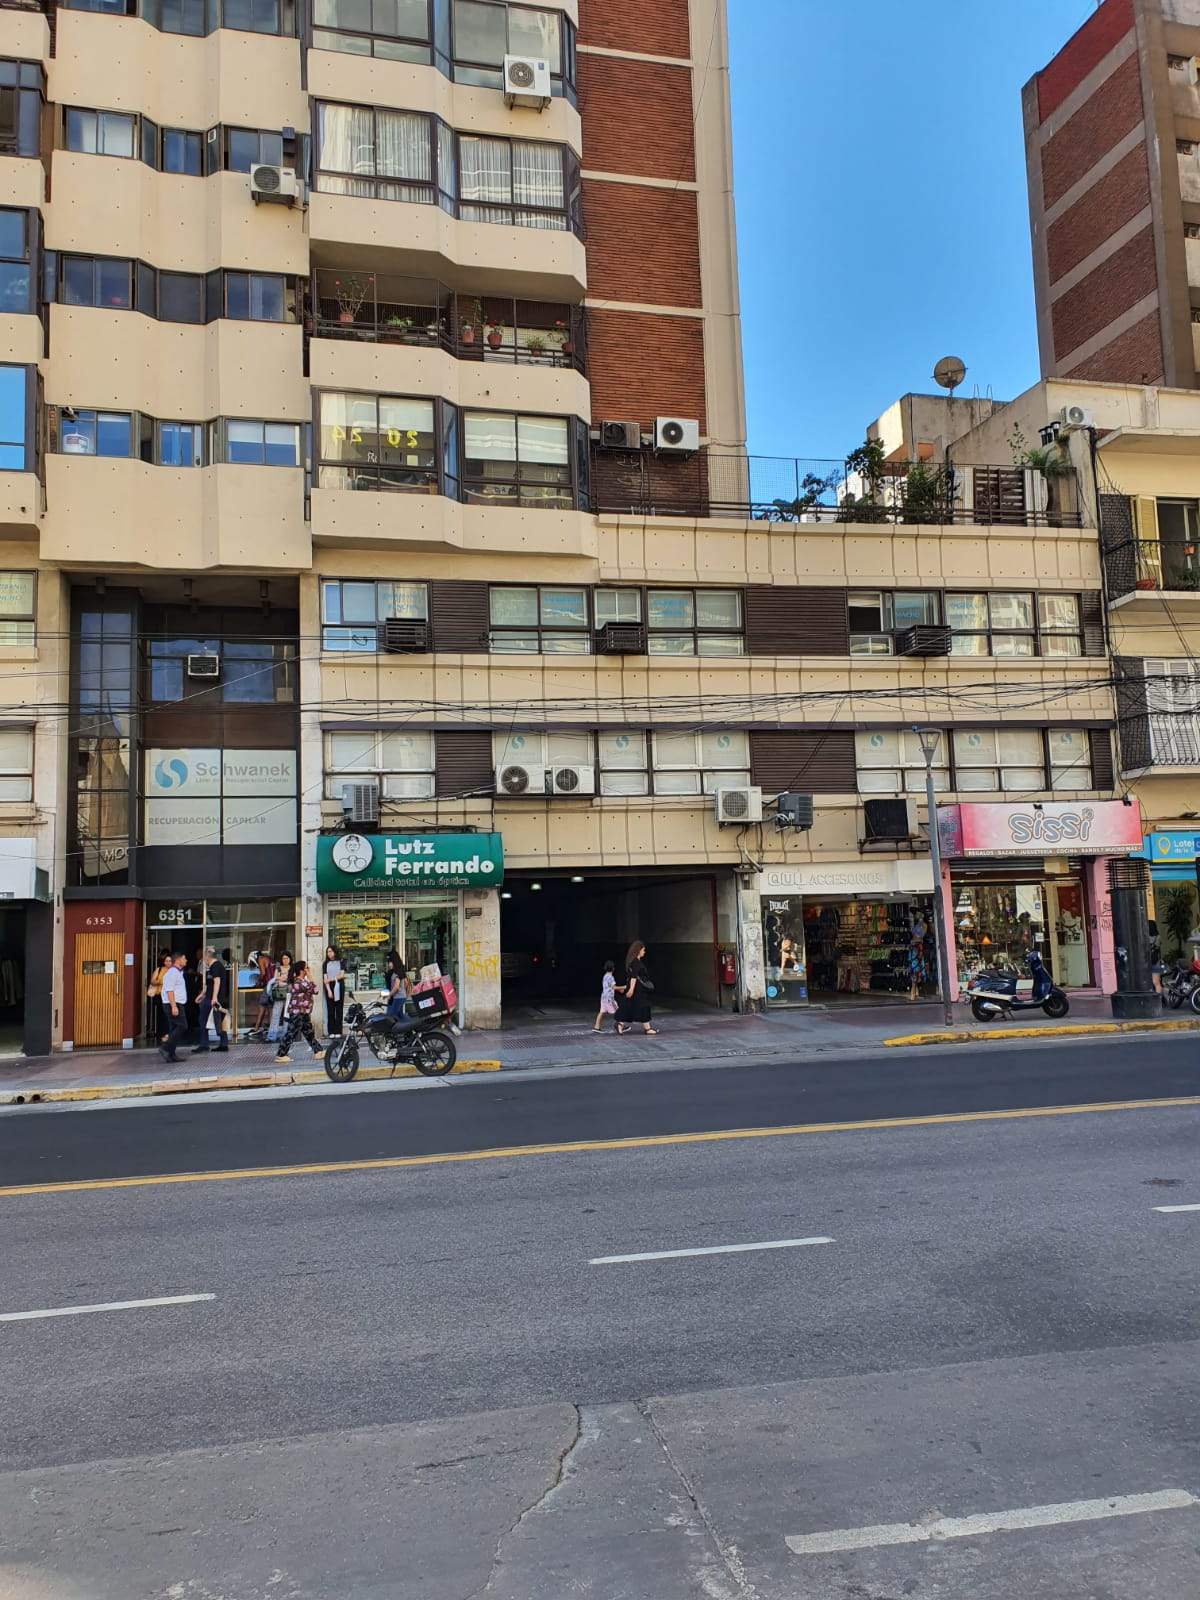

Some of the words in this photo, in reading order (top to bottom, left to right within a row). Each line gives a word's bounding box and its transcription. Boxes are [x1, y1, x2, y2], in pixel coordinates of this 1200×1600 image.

[195, 762, 290, 776] Schwanek
[148, 816, 220, 825] RECUPERACIÓN
[226, 817, 266, 825] CAPILAR
[385, 839, 435, 855] Lutz
[385, 855, 495, 875] Ferrando
[353, 878, 393, 888] Calidad
[395, 877, 420, 887] total
[438, 876, 470, 887] óptica
[769, 900, 790, 911] EVERLAST
[86, 916, 113, 926] 6353
[158, 909, 193, 921] 6351
